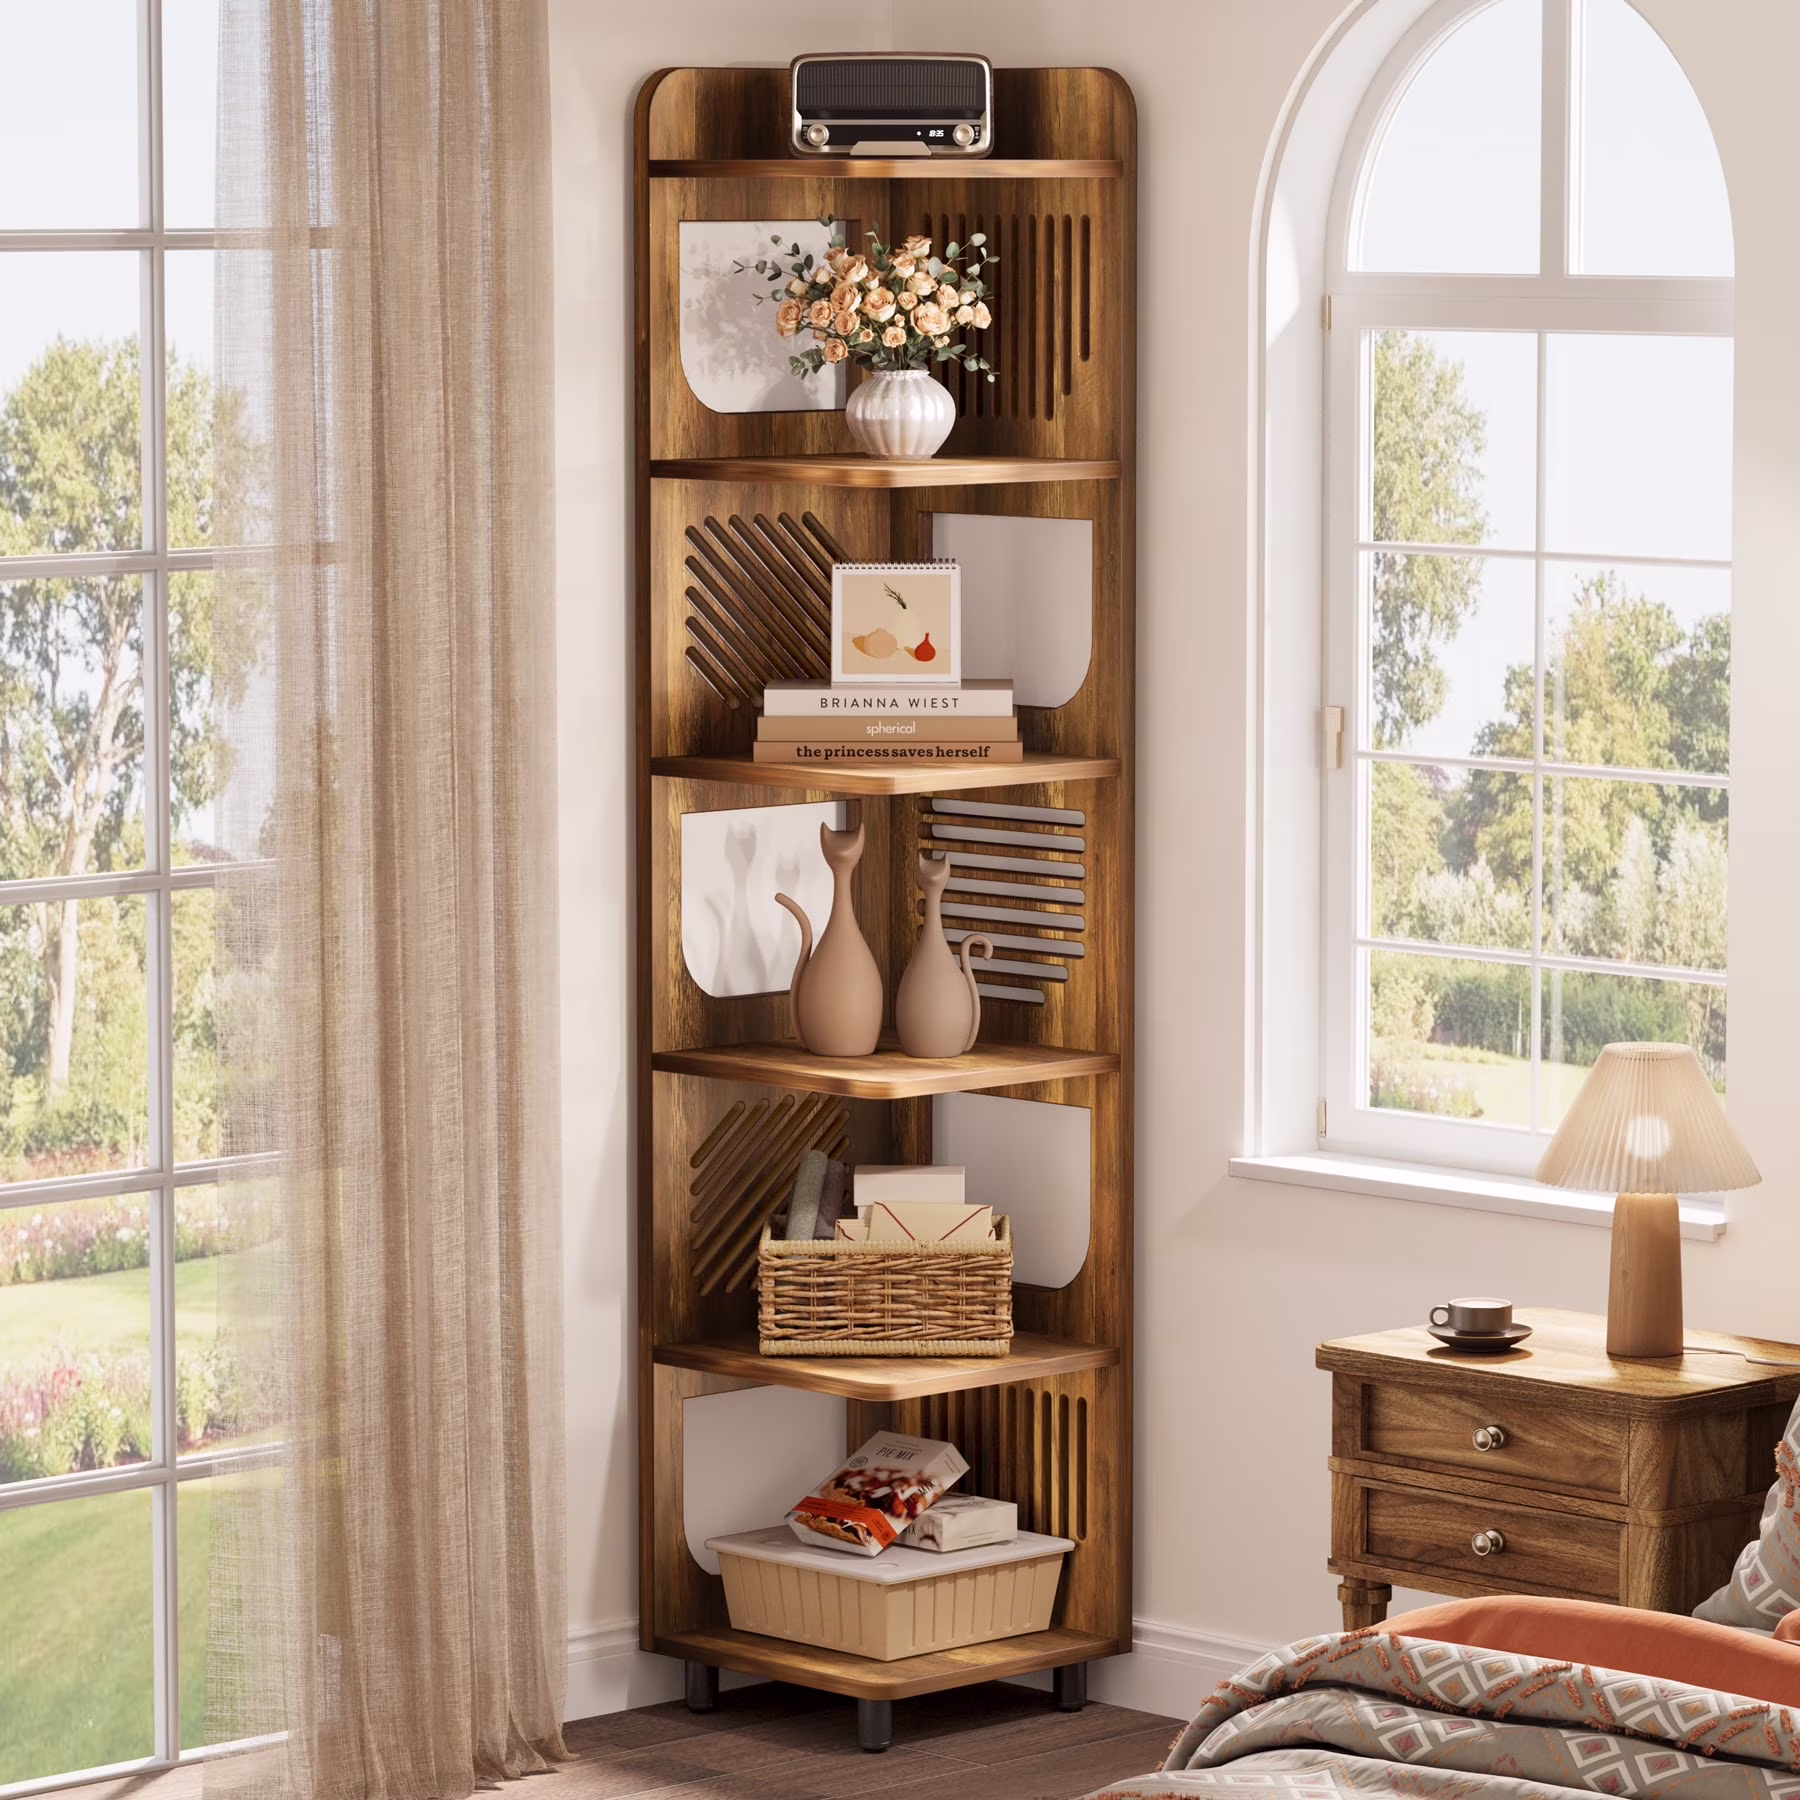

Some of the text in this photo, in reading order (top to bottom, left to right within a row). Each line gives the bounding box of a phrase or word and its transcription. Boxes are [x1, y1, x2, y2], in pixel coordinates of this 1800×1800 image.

[820, 697, 959, 709] BRIANNA WIEST
[866, 721, 916, 736] spherical
[796, 746, 991, 760] the princess saves herself
[876, 1446, 894, 1458] PIE
[895, 1450, 917, 1462] MIX
